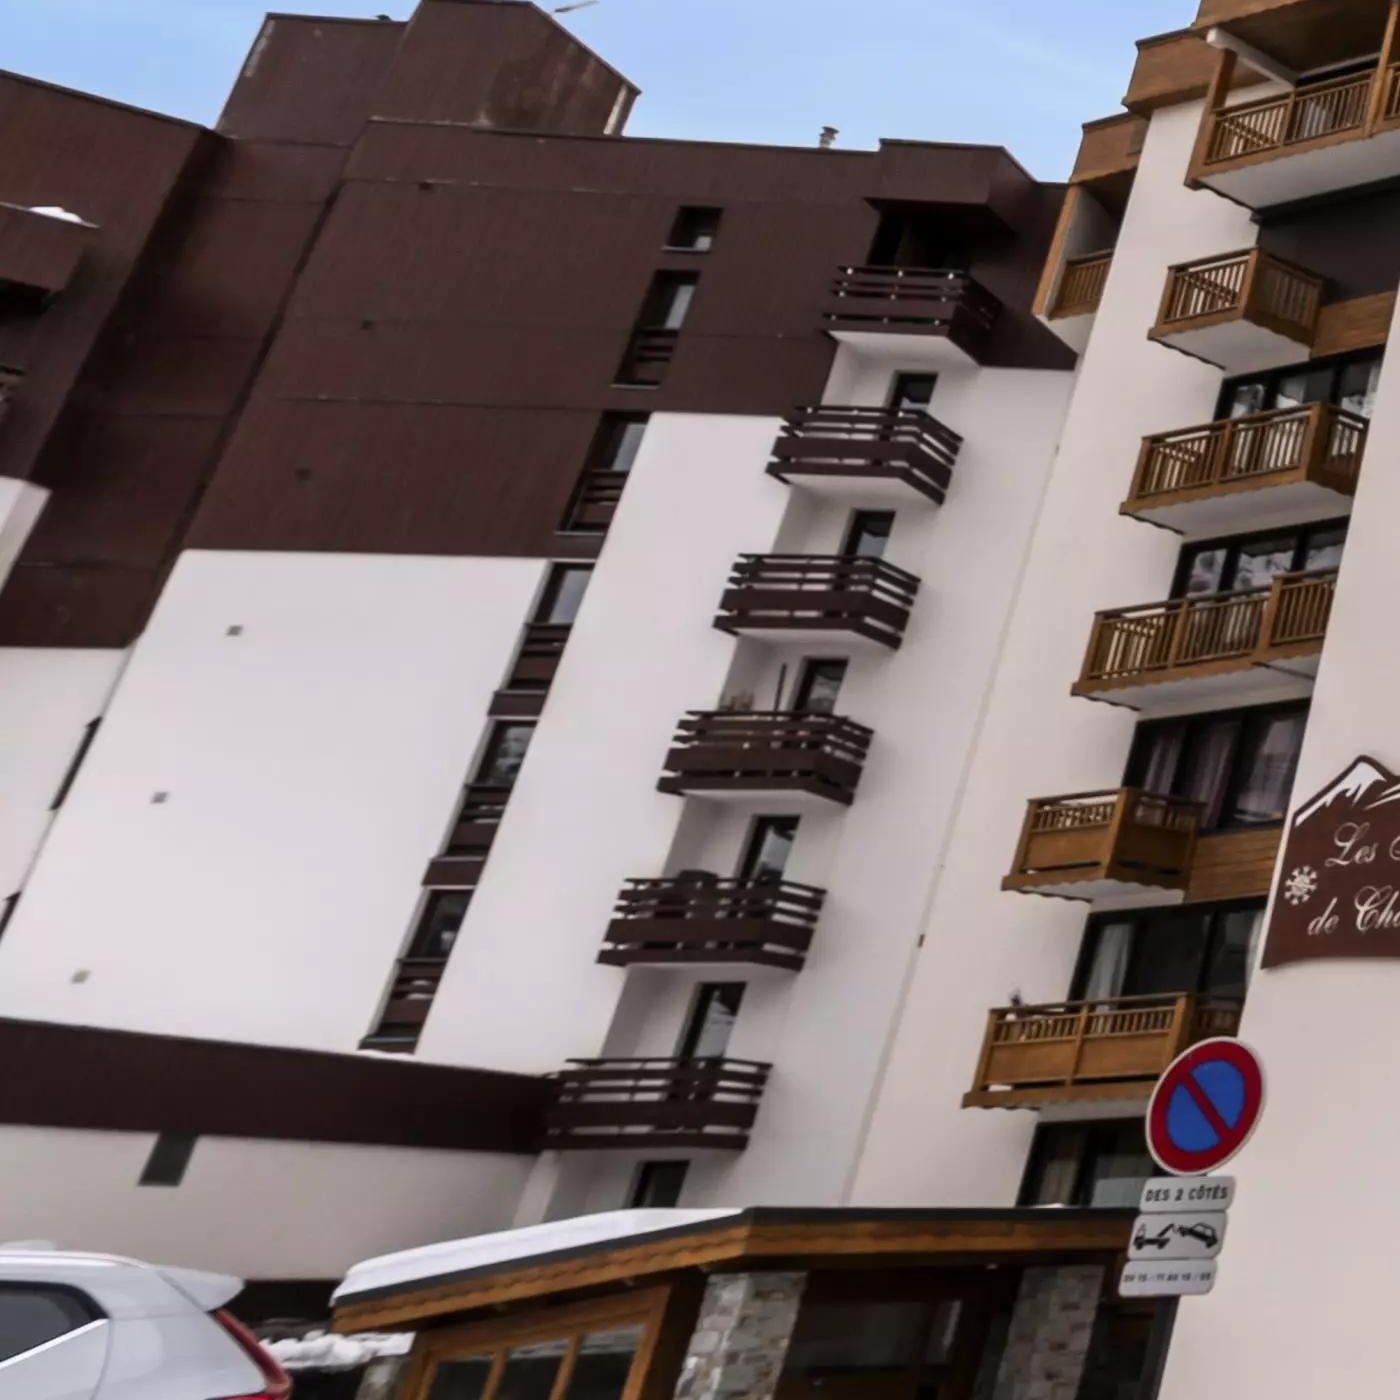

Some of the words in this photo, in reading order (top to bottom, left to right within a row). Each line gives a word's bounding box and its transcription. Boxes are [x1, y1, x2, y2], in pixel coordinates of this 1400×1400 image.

[1325, 822, 1378, 867] Les
[1307, 897, 1340, 935] de
[1145, 1188, 1170, 1202] DES
[1174, 1187, 1184, 1201] 2
[1188, 1184, 1229, 1200] CÔTÉS
